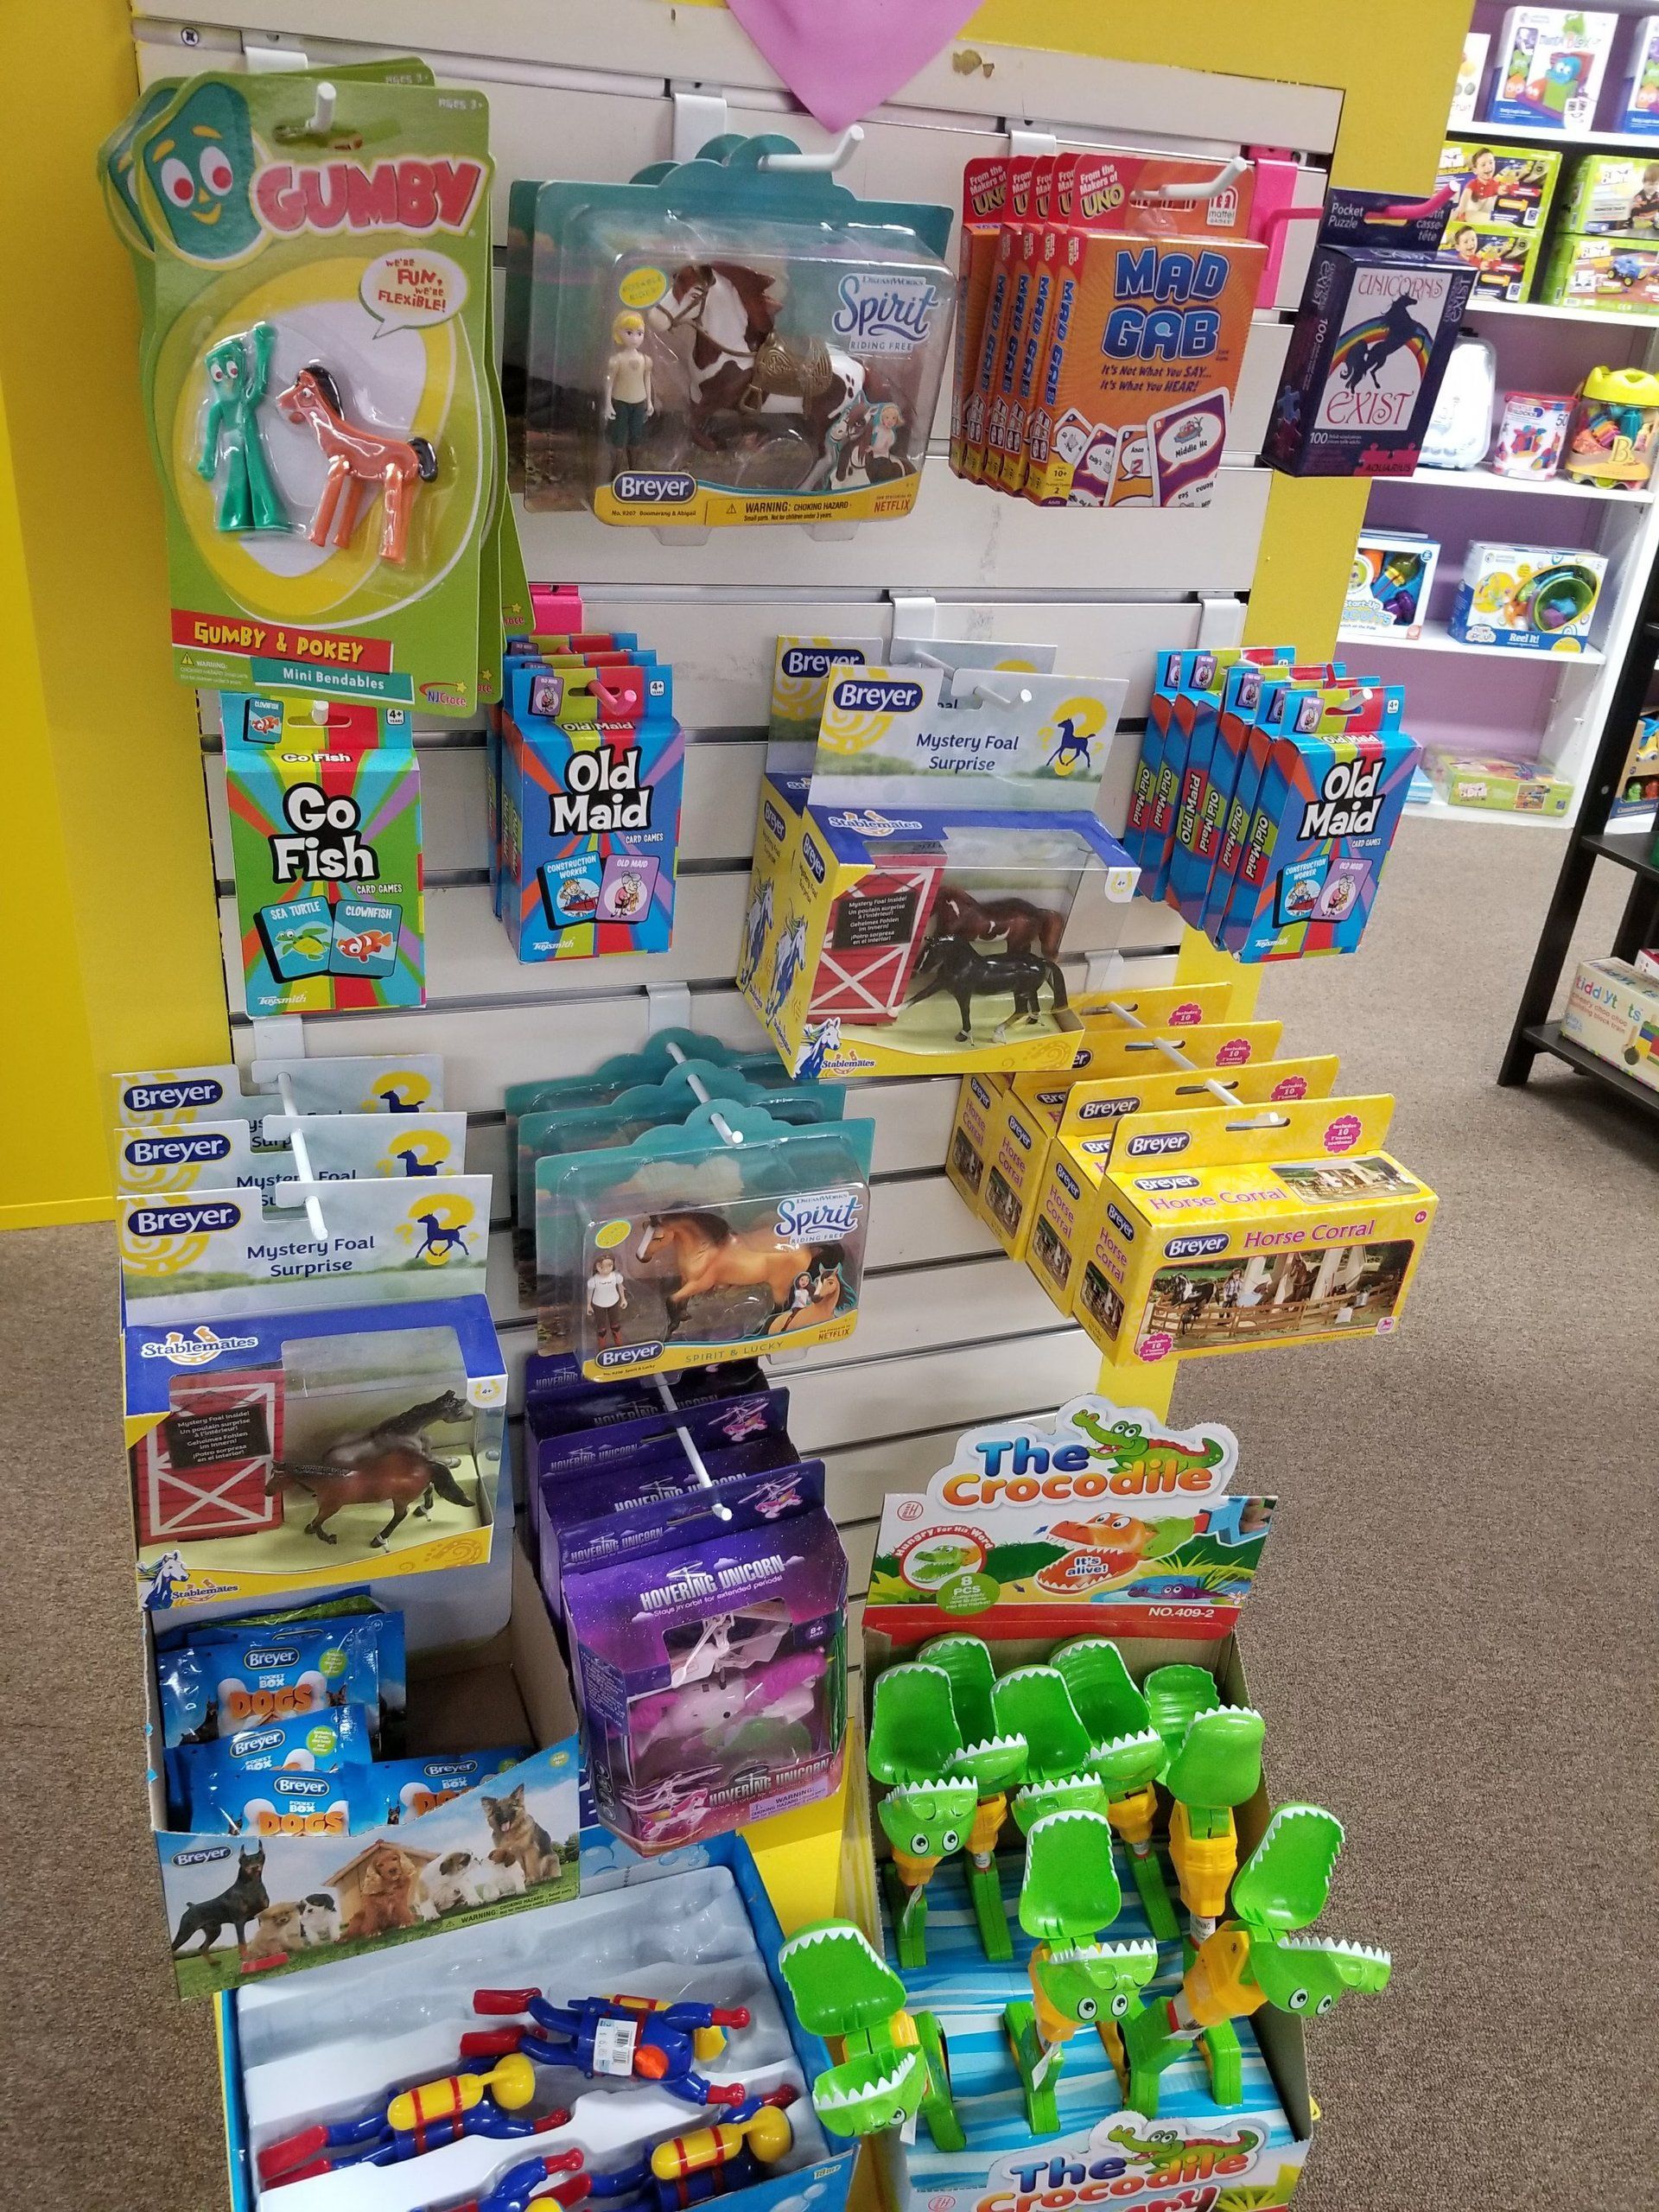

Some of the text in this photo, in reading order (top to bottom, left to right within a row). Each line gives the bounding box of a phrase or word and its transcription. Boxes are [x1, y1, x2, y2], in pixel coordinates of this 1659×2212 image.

[1080, 164, 1115, 183] From the
[1080, 171, 1118, 194] Makers of
[256, 160, 480, 232] GUMBY
[1081, 183, 1124, 219] UNO
[1332, 202, 1363, 218] Pocket
[1328, 216, 1358, 229] Puzzle
[1416, 219, 1443, 231] casse-
[397, 268, 443, 286] FUN,
[1115, 246, 1230, 302] MAD
[1358, 273, 1444, 298] UNICORNS
[835, 275, 938, 336] Spirit
[1102, 305, 1222, 361] GAB
[1046, 280, 1075, 406] MAD GAB
[1102, 365, 1119, 375] It's
[1121, 365, 1137, 376] Not
[1139, 365, 1163, 377] What
[1165, 366, 1181, 378] You
[1100, 380, 1198, 392] It's What You HEAR!
[1309, 432, 1328, 444] 100
[1175, 441, 1208, 458] Middle He
[1366, 463, 1411, 472] AQUARIUS
[620, 476, 689, 501] Breyer
[746, 500, 848, 513] WARNING: CHOKING HAZARD
[874, 499, 912, 512] NETFLIX
[194, 621, 364, 663] GUMBY & POKEY
[1510, 633, 1525, 643] Reel
[283, 667, 385, 690] Mini Bendables
[842, 683, 917, 711] Breyer
[917, 733, 1020, 753] Mystery Foal
[282, 752, 352, 764] Go Fish
[928, 756, 995, 773] Surprise
[568, 749, 639, 792] Old
[1324, 760, 1382, 798] Old
[288, 785, 357, 832] Go
[552, 791, 652, 833] Maid
[1300, 796, 1382, 836] Maid
[829, 816, 922, 832] Stablemates
[626, 833, 664, 844] CARD GAMES
[273, 835, 375, 880] Fish
[546, 855, 597, 873] CONSTRUCTION
[616, 859, 648, 868] OLD MAID
[560, 865, 588, 880] WORKER
[356, 884, 403, 894] CARD GAMES
[270, 901, 321, 920] SEA TURTLE
[346, 906, 392, 918] CLOWNFISH
[257, 995, 307, 1006] Toysmith
[1132, 1135, 1186, 1155] Breyer
[1150, 1187, 1287, 1211] Horse Corral
[137, 1206, 232, 1235] Breyer
[1415, 1214, 1427, 1223] 4+
[1243, 1220, 1376, 1249] Horse Corral
[247, 1235, 375, 1261] Mystery Foal
[1166, 1236, 1227, 1259] Breyer
[270, 1259, 353, 1278] Surprise
[143, 1336, 257, 1357] Stablemates
[603, 1345, 658, 1365] Breyer
[685, 1351, 724, 1363] SPIRIT
[744, 1342, 784, 1353] LUCKY
[178, 1419, 207, 1427] Mystery
[226, 1410, 250, 1420] Inside!
[192, 1424, 219, 1433] poulain
[221, 1419, 251, 1427] surprise
[187, 1431, 248, 1446] Geheimes Fohlen
[211, 1439, 237, 1447] Innern!
[215, 1450, 245, 1459] interior!
[216, 1444, 247, 1454] sorpresa
[976, 1437, 1090, 1477] The
[942, 1459, 1212, 1506] Crocodile
[895, 1528, 934, 1555] Hungry
[971, 1528, 993, 1548] Word
[1065, 1563, 1109, 1577] alive!
[1073, 1554, 1100, 1567] It's
[640, 1554, 785, 1611] HOVERING UNICORN
[953, 1584, 982, 1596] PCS
[961, 1575, 972, 1586] 8
[653, 1606, 675, 1617] Stays
[683, 1599, 703, 1609] orbit
[704, 1594, 715, 1603] for
[716, 1585, 753, 1599] extended
[753, 1574, 783, 1590] periods!
[1147, 1606, 1215, 1618] NO.409-2
[249, 1649, 296, 1668] Breyer
[259, 1678, 285, 1688] BOX
[229, 1683, 314, 1719] DOGS
[776, 1787, 815, 1803] WARNING:
[258, 1812, 345, 1835] DOGS
[176, 1847, 228, 1866] Breyer
[461, 1909, 499, 1923] WARNING:
[976, 2150, 1249, 2212] Crocodile
[1009, 2156, 1128, 2193] The
